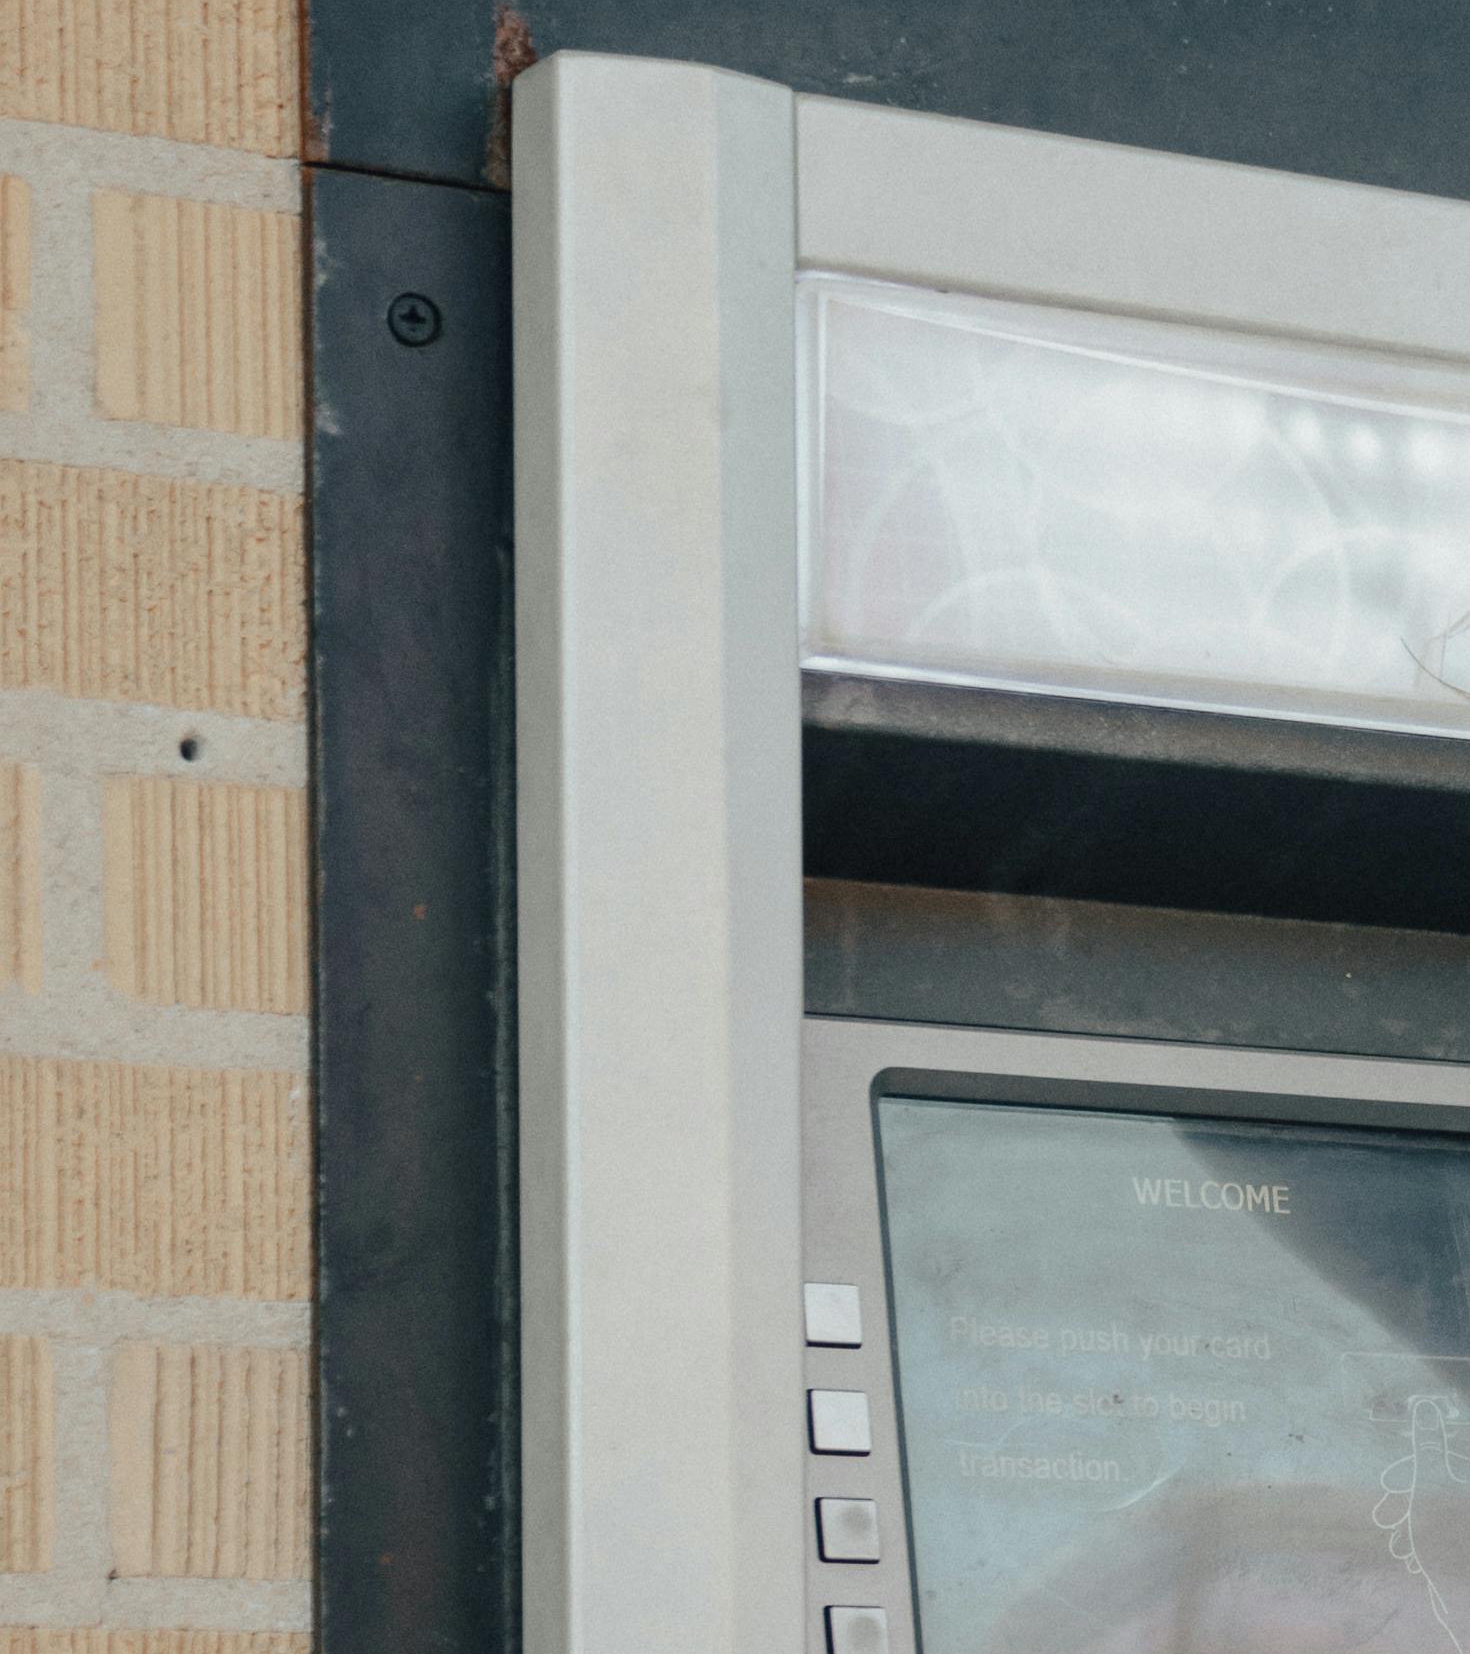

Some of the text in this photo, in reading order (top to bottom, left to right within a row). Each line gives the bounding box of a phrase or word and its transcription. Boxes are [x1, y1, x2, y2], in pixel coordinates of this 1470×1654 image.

[1132, 1176, 1291, 1214] WELCOME
[951, 1316, 1271, 1362] Please push your card
[1168, 1393, 1247, 1427] begin
